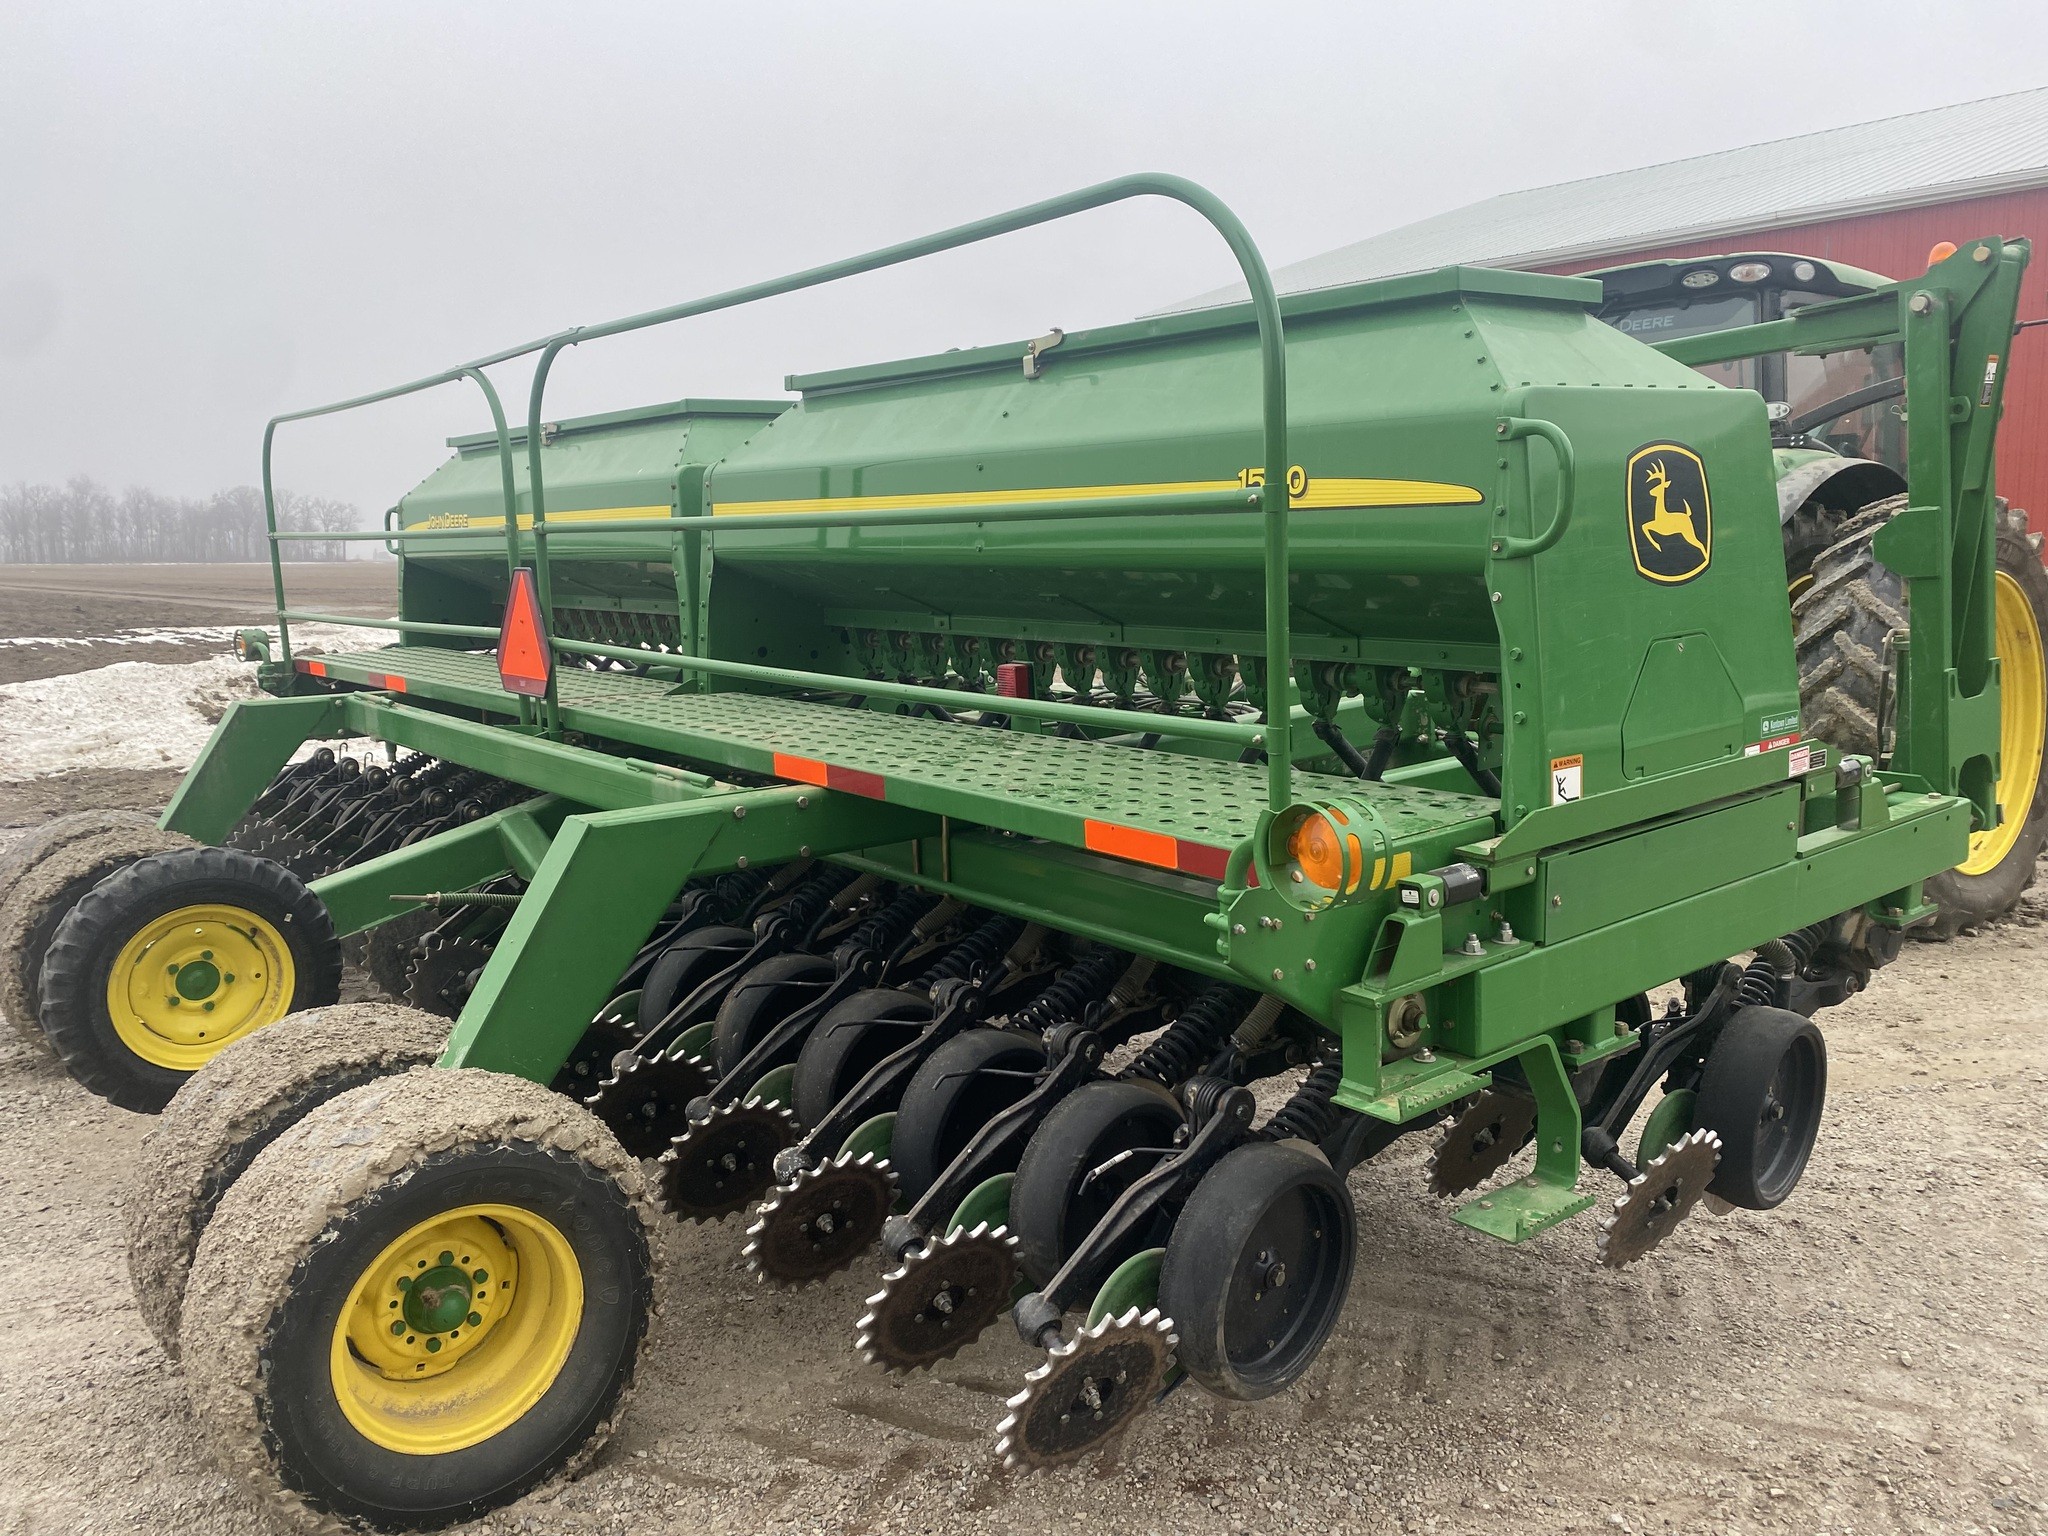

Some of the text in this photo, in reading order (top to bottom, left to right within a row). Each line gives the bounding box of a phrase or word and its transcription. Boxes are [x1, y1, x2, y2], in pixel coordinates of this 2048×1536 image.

[1620, 315, 1674, 332] DEERE
[1237, 464, 1307, 499] 150
[445, 512, 468, 529] DEERE
[1772, 737, 1790, 748] DANGER
[1558, 756, 1581, 767] WARNING
